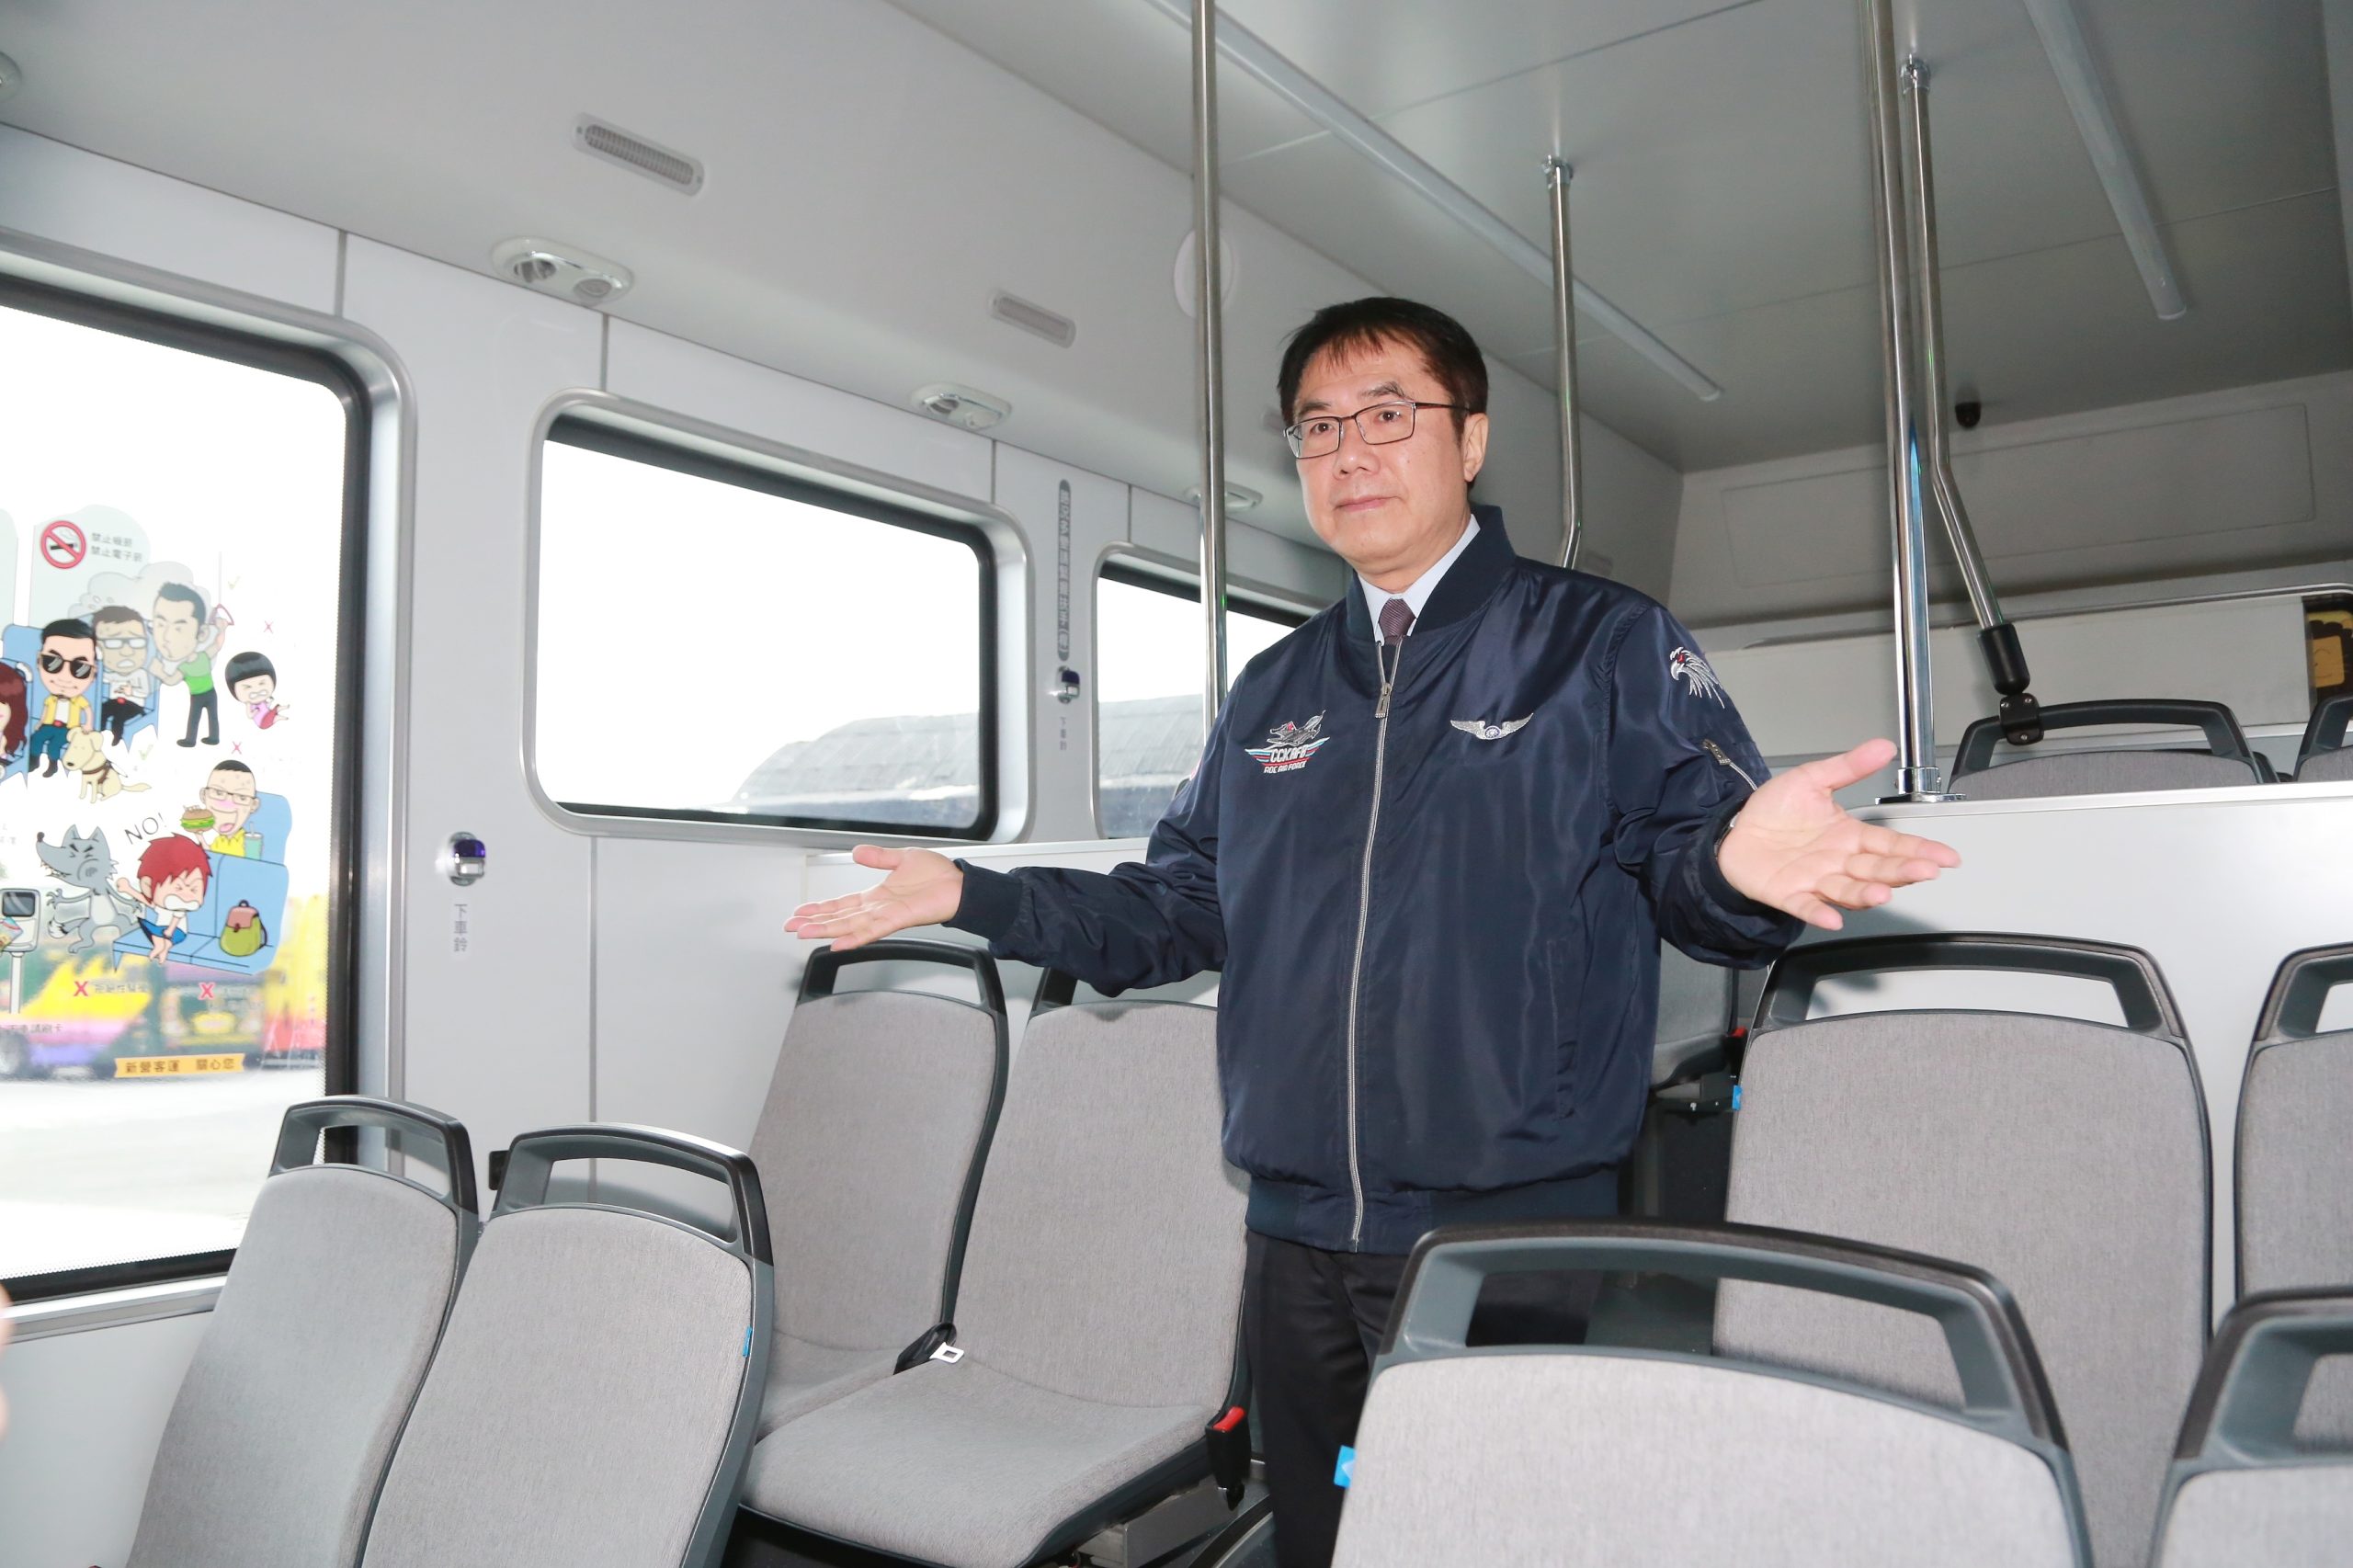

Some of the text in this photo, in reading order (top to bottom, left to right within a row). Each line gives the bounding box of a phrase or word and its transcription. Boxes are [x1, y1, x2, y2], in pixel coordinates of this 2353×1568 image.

[1264, 766, 1278, 774] ROC
[1288, 760, 1307, 770] FORCE
[124, 812, 167, 845] NO!
[454, 903, 468, 952] 下車鈴
[125, 1058, 234, 1074] 新營客運 關心您
